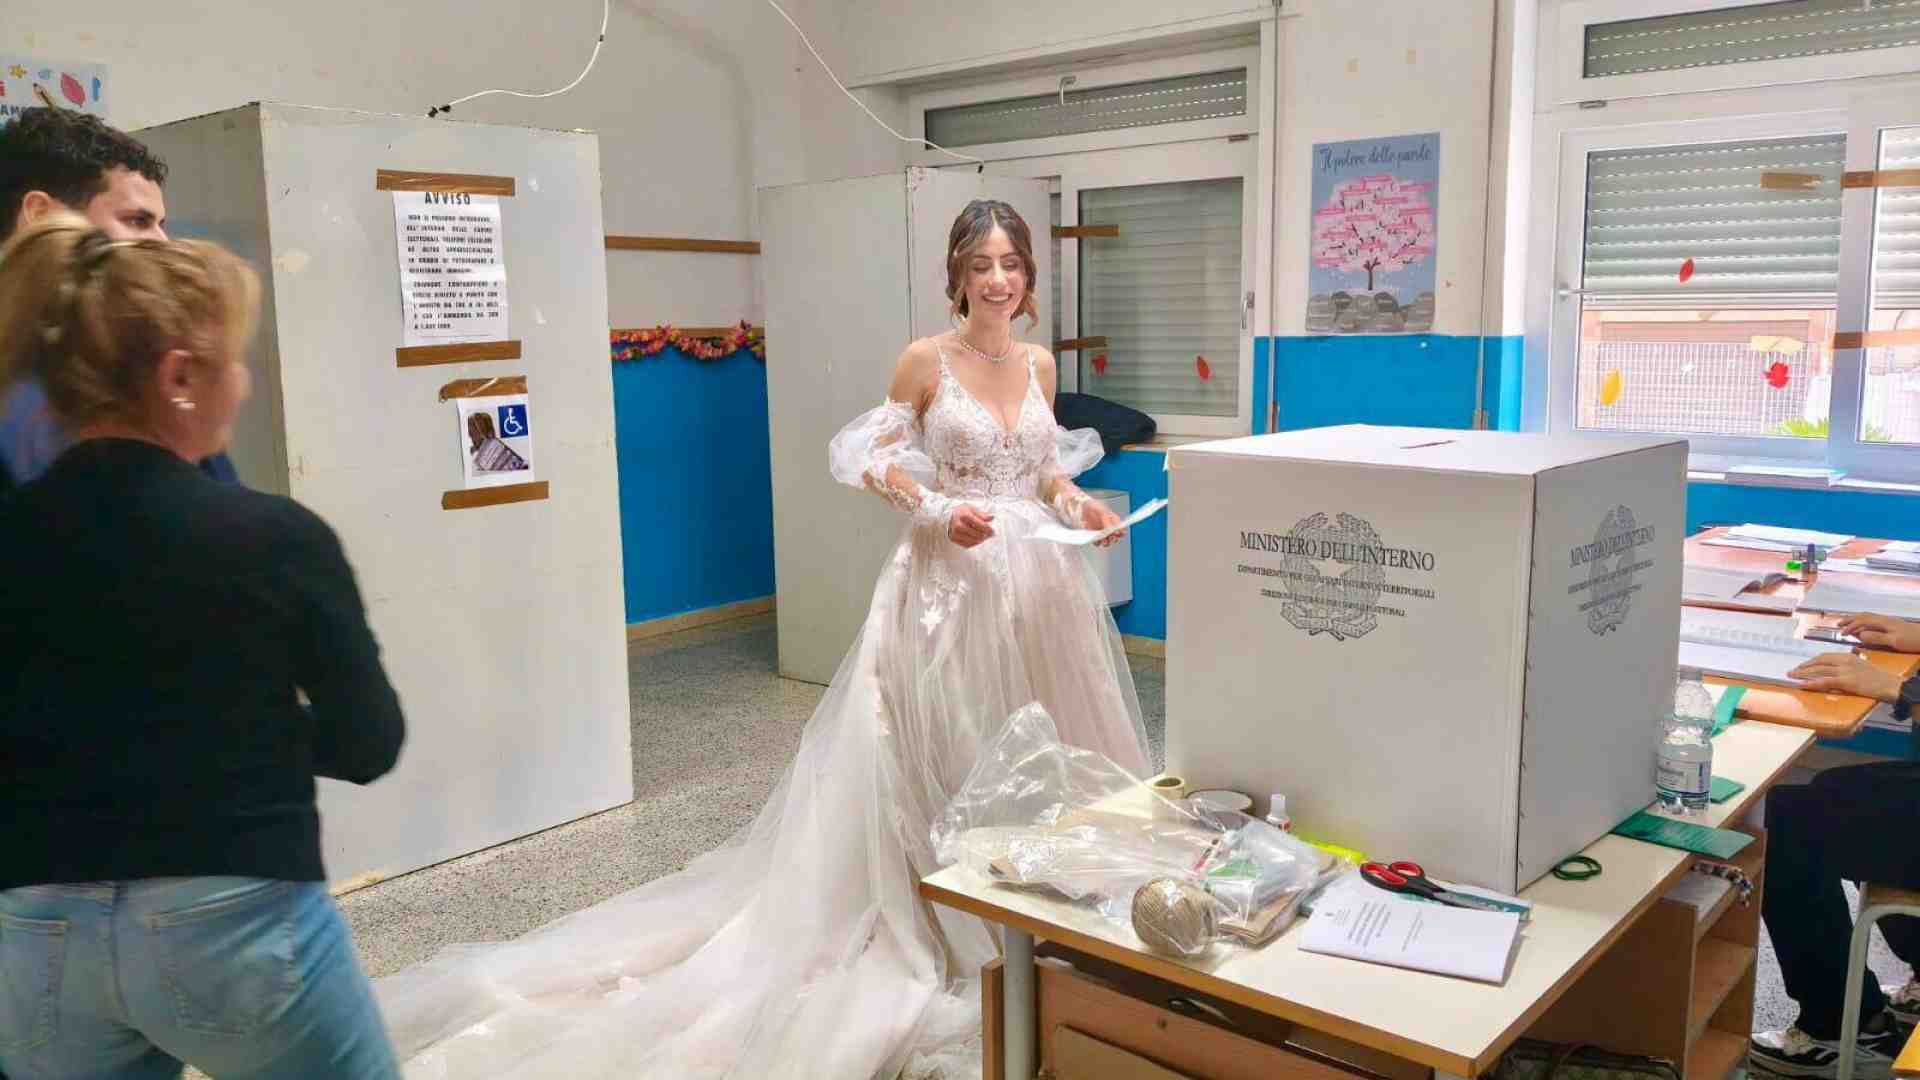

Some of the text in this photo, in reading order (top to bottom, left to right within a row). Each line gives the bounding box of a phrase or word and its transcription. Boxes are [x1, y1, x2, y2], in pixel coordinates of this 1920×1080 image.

[425, 192, 470, 204] AVVISO
[1240, 531, 1435, 571] MINISTERO DELL'INTERNO
